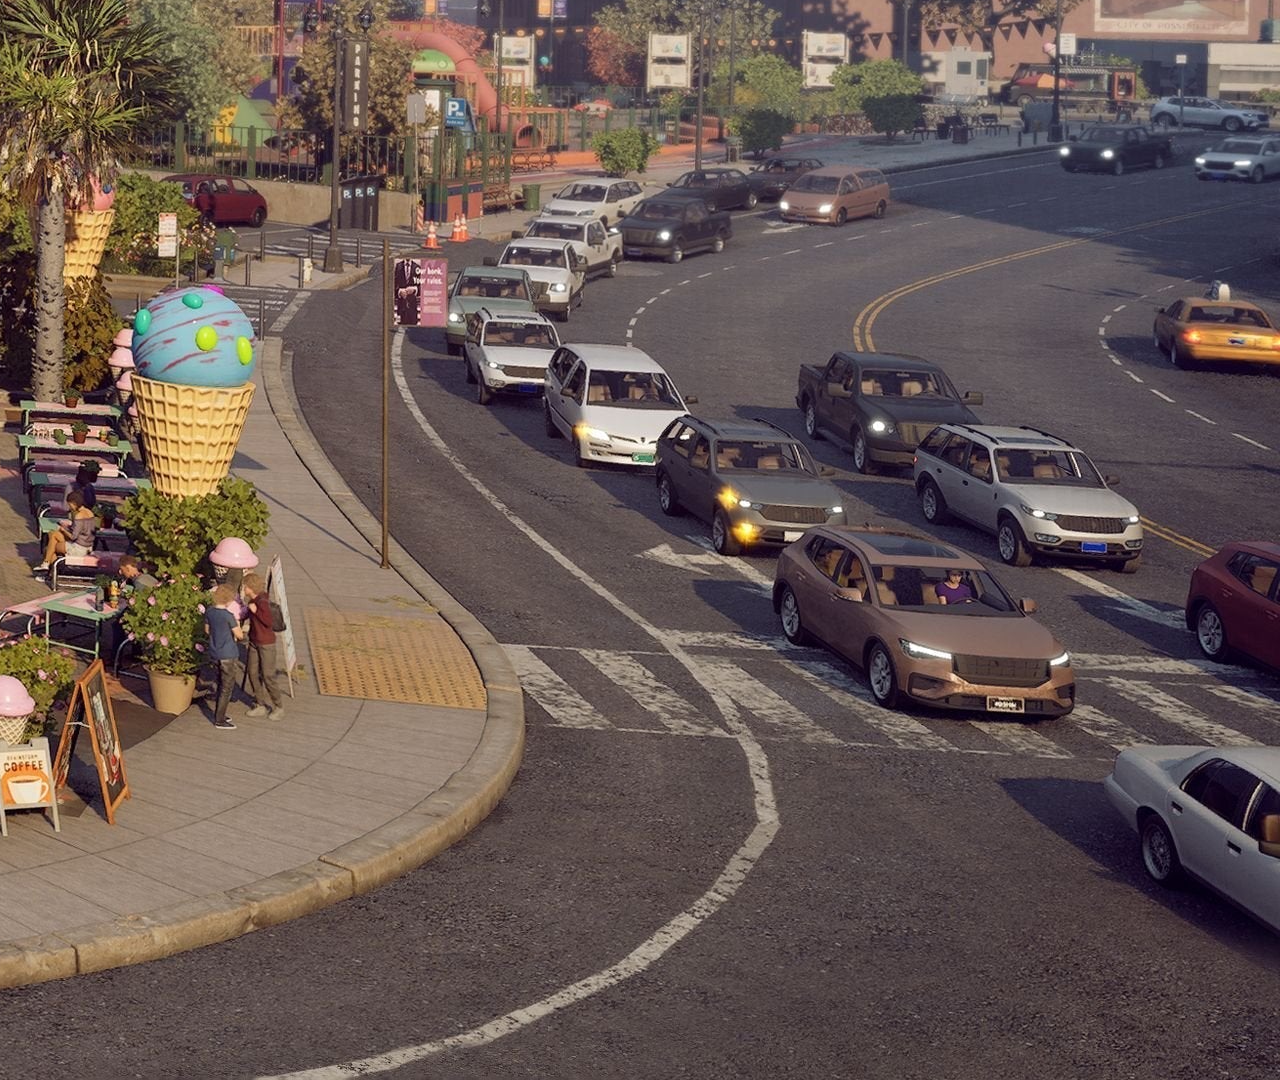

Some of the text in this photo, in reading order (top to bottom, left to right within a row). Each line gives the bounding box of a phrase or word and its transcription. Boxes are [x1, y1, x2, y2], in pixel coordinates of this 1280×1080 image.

[353, 44, 361, 127] PARKING
[448, 101, 459, 116] P
[3, 760, 43, 772] COFFEE
